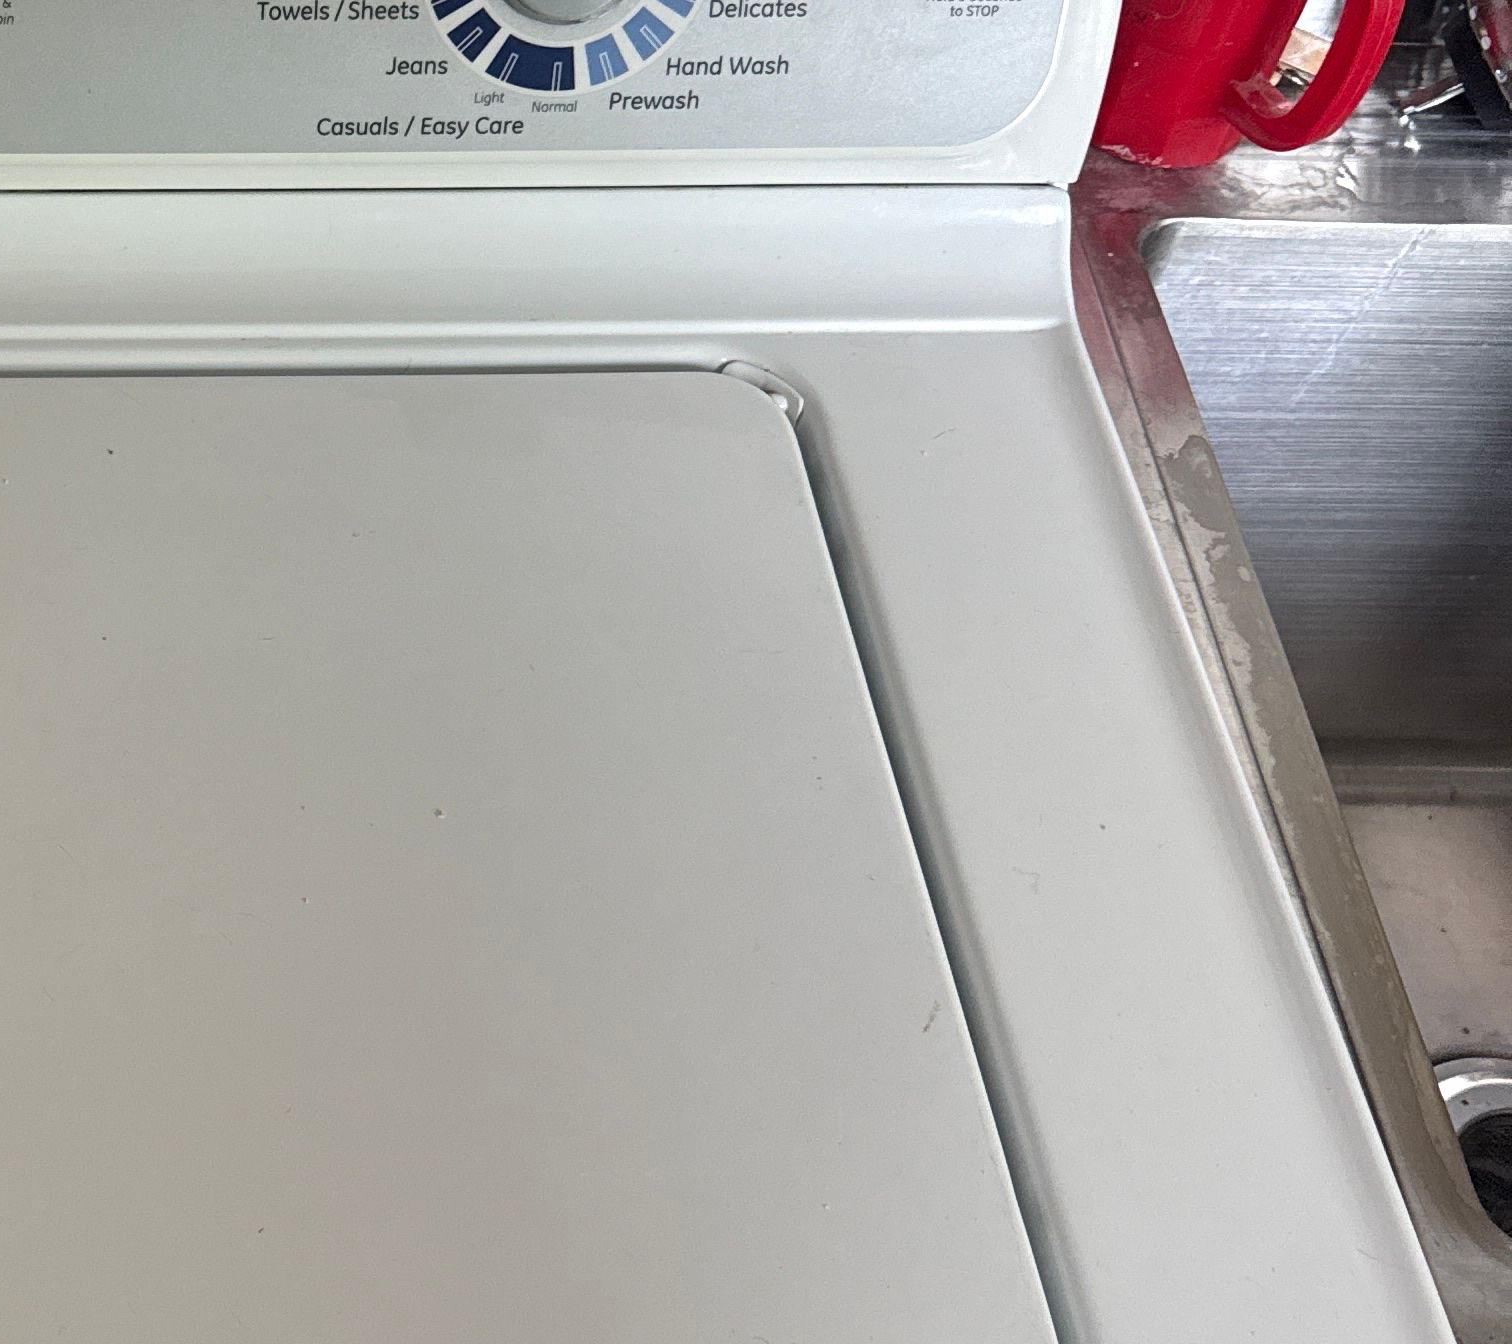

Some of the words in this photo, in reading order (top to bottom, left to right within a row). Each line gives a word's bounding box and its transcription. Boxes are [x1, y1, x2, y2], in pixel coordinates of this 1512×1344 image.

[257, 0, 329, 20] Towels
[348, 0, 419, 20] Sheets
[950, 6, 963, 17] to
[966, 5, 999, 16] STOP
[386, 57, 448, 75] Jeans
[666, 56, 722, 75] Hand
[730, 55, 788, 75] Wash
[474, 92, 504, 106] Light
[532, 101, 577, 112] Normal
[609, 90, 699, 110] Prewash
[317, 116, 398, 136] Casuals
[421, 118, 469, 139] Easy
[476, 117, 523, 134] Care
